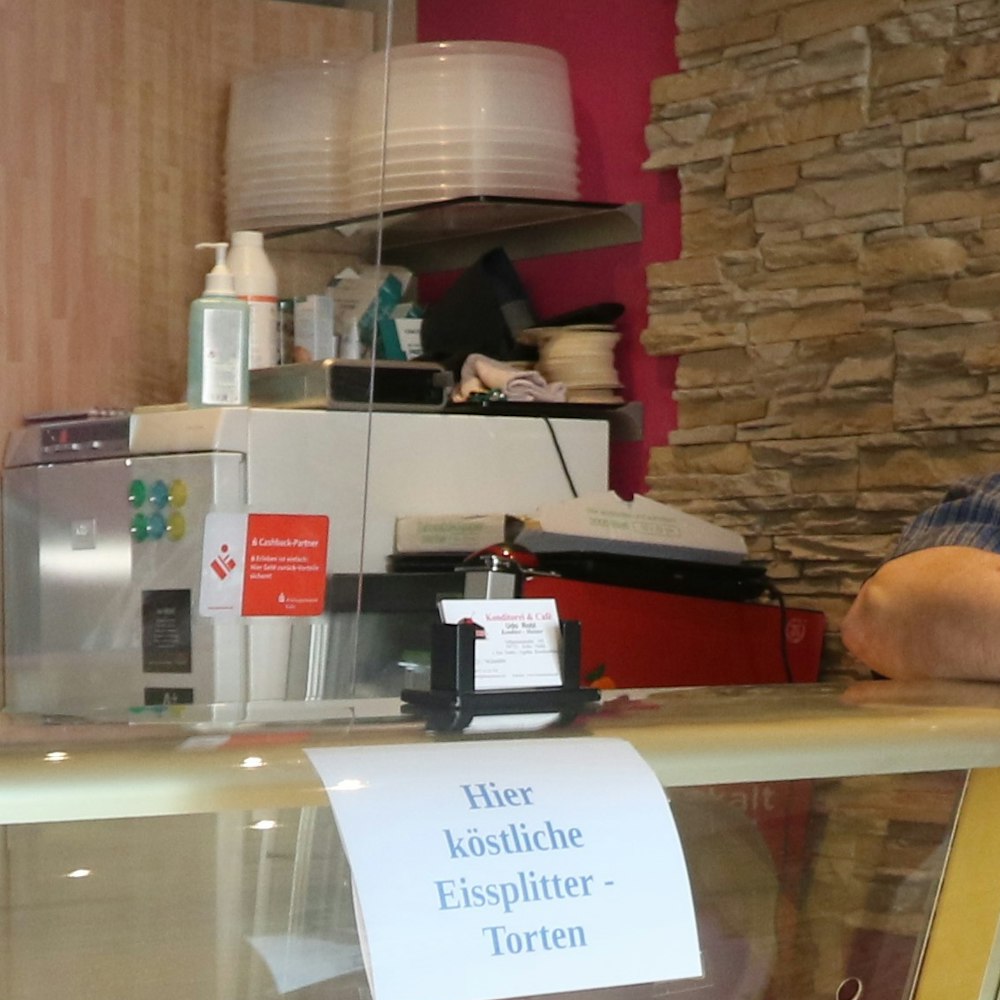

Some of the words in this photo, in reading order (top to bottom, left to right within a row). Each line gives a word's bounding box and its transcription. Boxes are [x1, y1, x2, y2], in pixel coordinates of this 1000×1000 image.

[259, 538, 319, 548] Cashback-Partner
[459, 781, 534, 810] Hier
[443, 820, 585, 859] köstliche
[433, 870, 594, 913] Eissplitter
[482, 924, 588, 957] Torten
